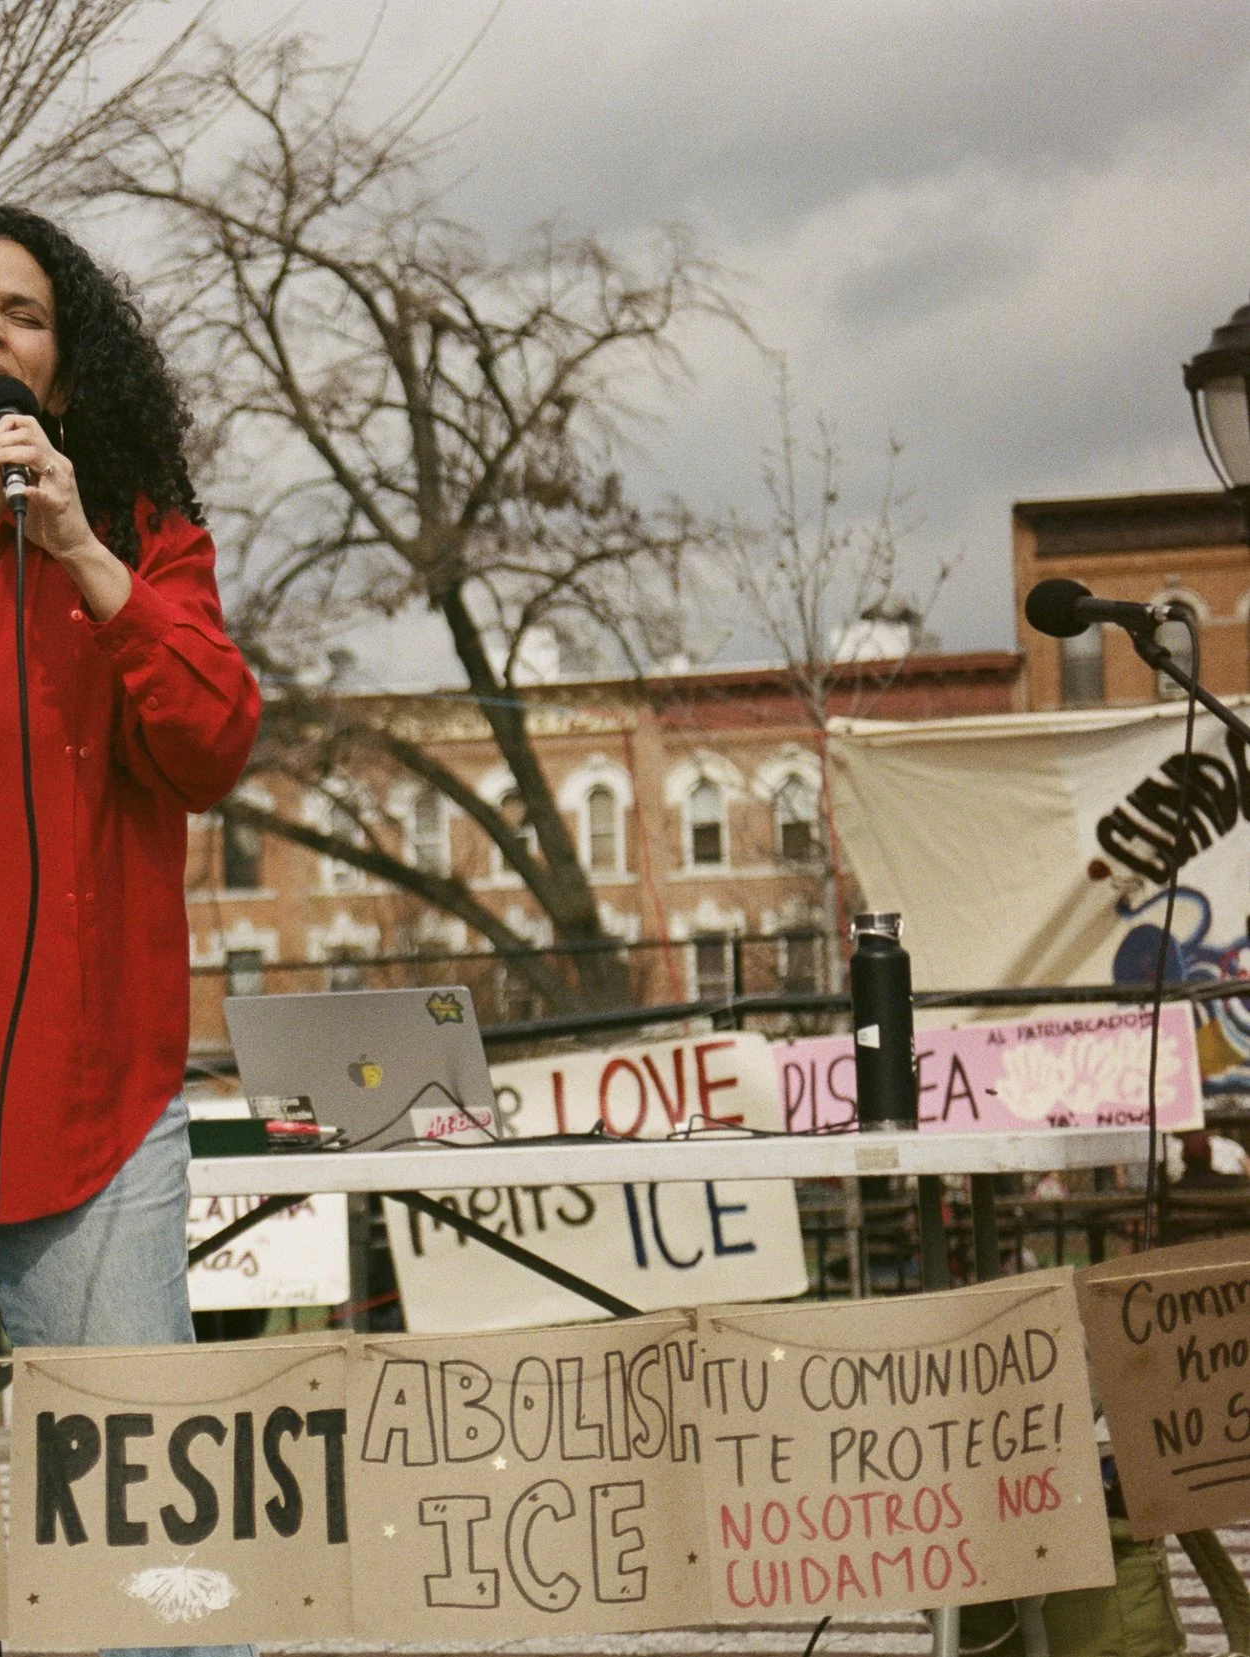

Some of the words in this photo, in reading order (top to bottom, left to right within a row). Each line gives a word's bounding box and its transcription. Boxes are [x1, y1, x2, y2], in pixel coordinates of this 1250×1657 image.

[361, 1339, 701, 1467] ABOLISH
[800, 1328, 1058, 1412] COMUNIDAD
[715, 1432, 796, 1488] TE
[830, 1402, 1065, 1485] PROTEGE!
[1153, 1406, 1204, 1458] NO
[35, 1405, 349, 1547] RESIST
[720, 1482, 964, 1551] NOSOTROS
[997, 1467, 1063, 1522] NOS
[418, 1478, 649, 1613] ICE
[726, 1538, 988, 1610] CUIDAMOS.
